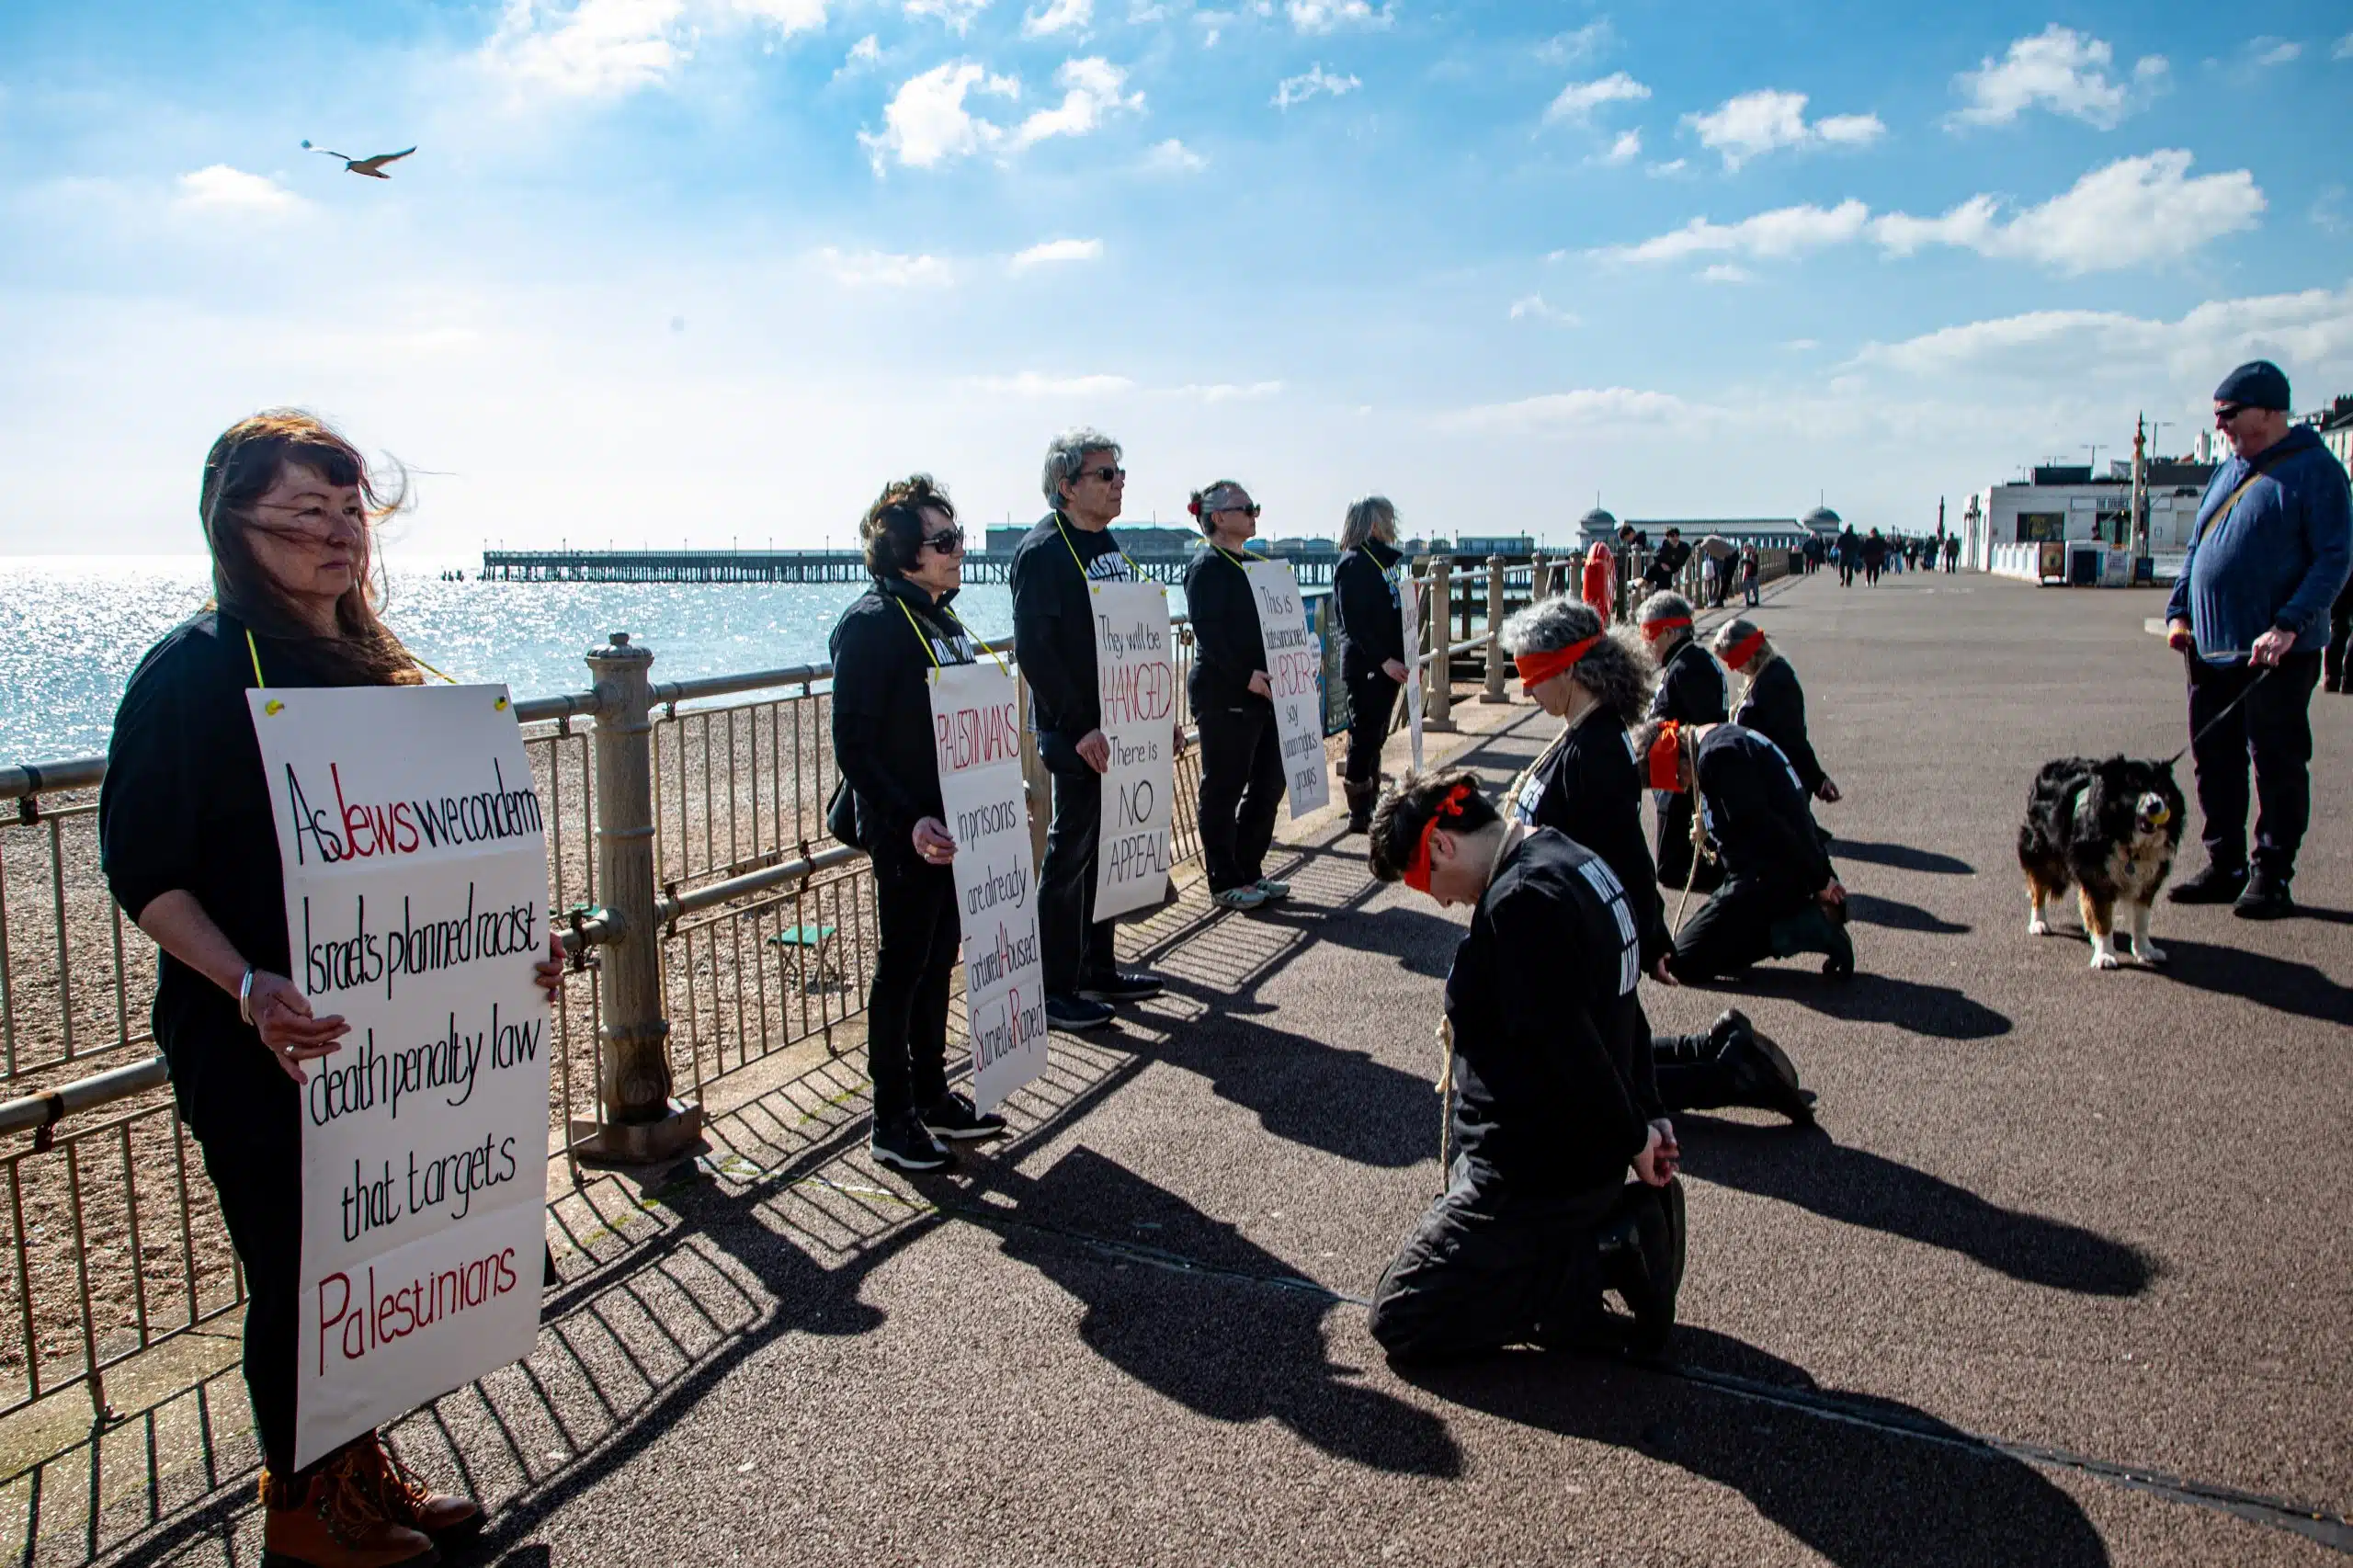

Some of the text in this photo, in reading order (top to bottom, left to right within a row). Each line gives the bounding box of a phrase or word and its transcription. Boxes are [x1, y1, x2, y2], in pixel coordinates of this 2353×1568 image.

[1260, 586, 1292, 615] This is
[1098, 614, 1162, 659] They will be
[1103, 661, 1172, 726] HANGED
[938, 702, 1020, 772] PALESTINIANS
[1109, 735, 1158, 767] There is
[285, 762, 342, 866] As
[329, 762, 421, 861] Jews
[412, 796, 462, 848] we
[957, 800, 1017, 852] in prisons
[1119, 779, 1154, 828] NO
[967, 854, 1028, 915] are already
[1107, 830, 1167, 887] APPEAL
[303, 881, 540, 1000] Israel's planned racist
[974, 1004, 1008, 1073] Starved
[1009, 983, 1044, 1054] Raped
[310, 1002, 541, 1127] death penalty law
[341, 1132, 517, 1243] that targets
[318, 1247, 517, 1378] Palestinians
